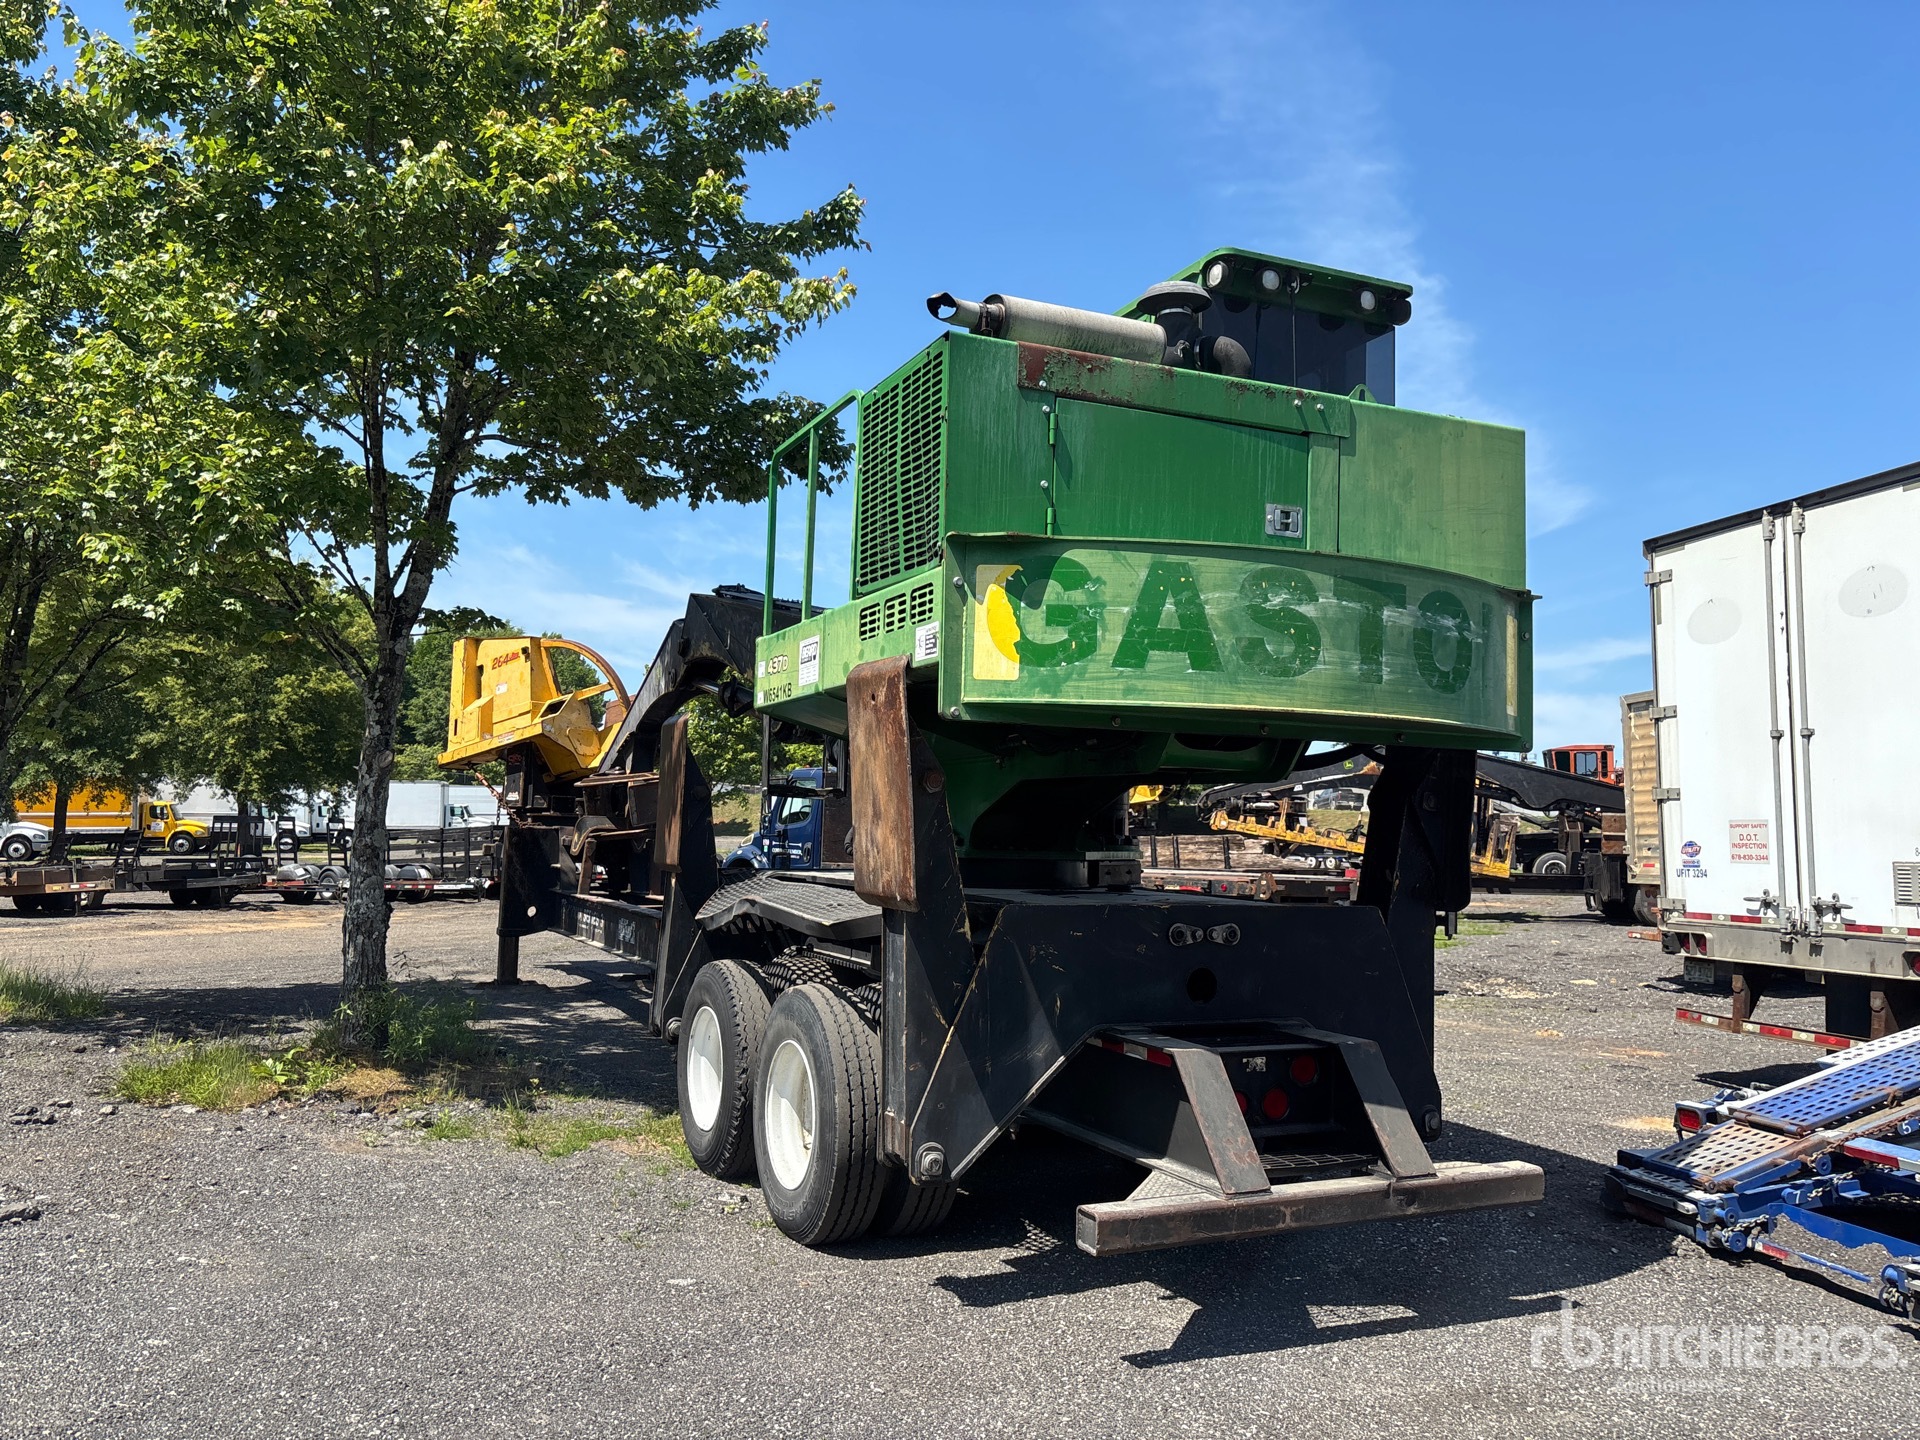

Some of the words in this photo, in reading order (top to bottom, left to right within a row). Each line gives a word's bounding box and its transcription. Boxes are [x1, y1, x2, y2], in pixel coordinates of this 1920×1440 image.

[491, 653, 509, 670] 264
[767, 654, 789, 676] 437D
[1738, 833, 1759, 842] D.O.T.
[1731, 842, 1768, 850] INSPECTION
[1731, 853, 1769, 861] 678-830-3344
[1676, 868, 1691, 878] UFIT
[1692, 868, 1708, 879] 3294
[1901, 1120, 1912, 1135] 5
